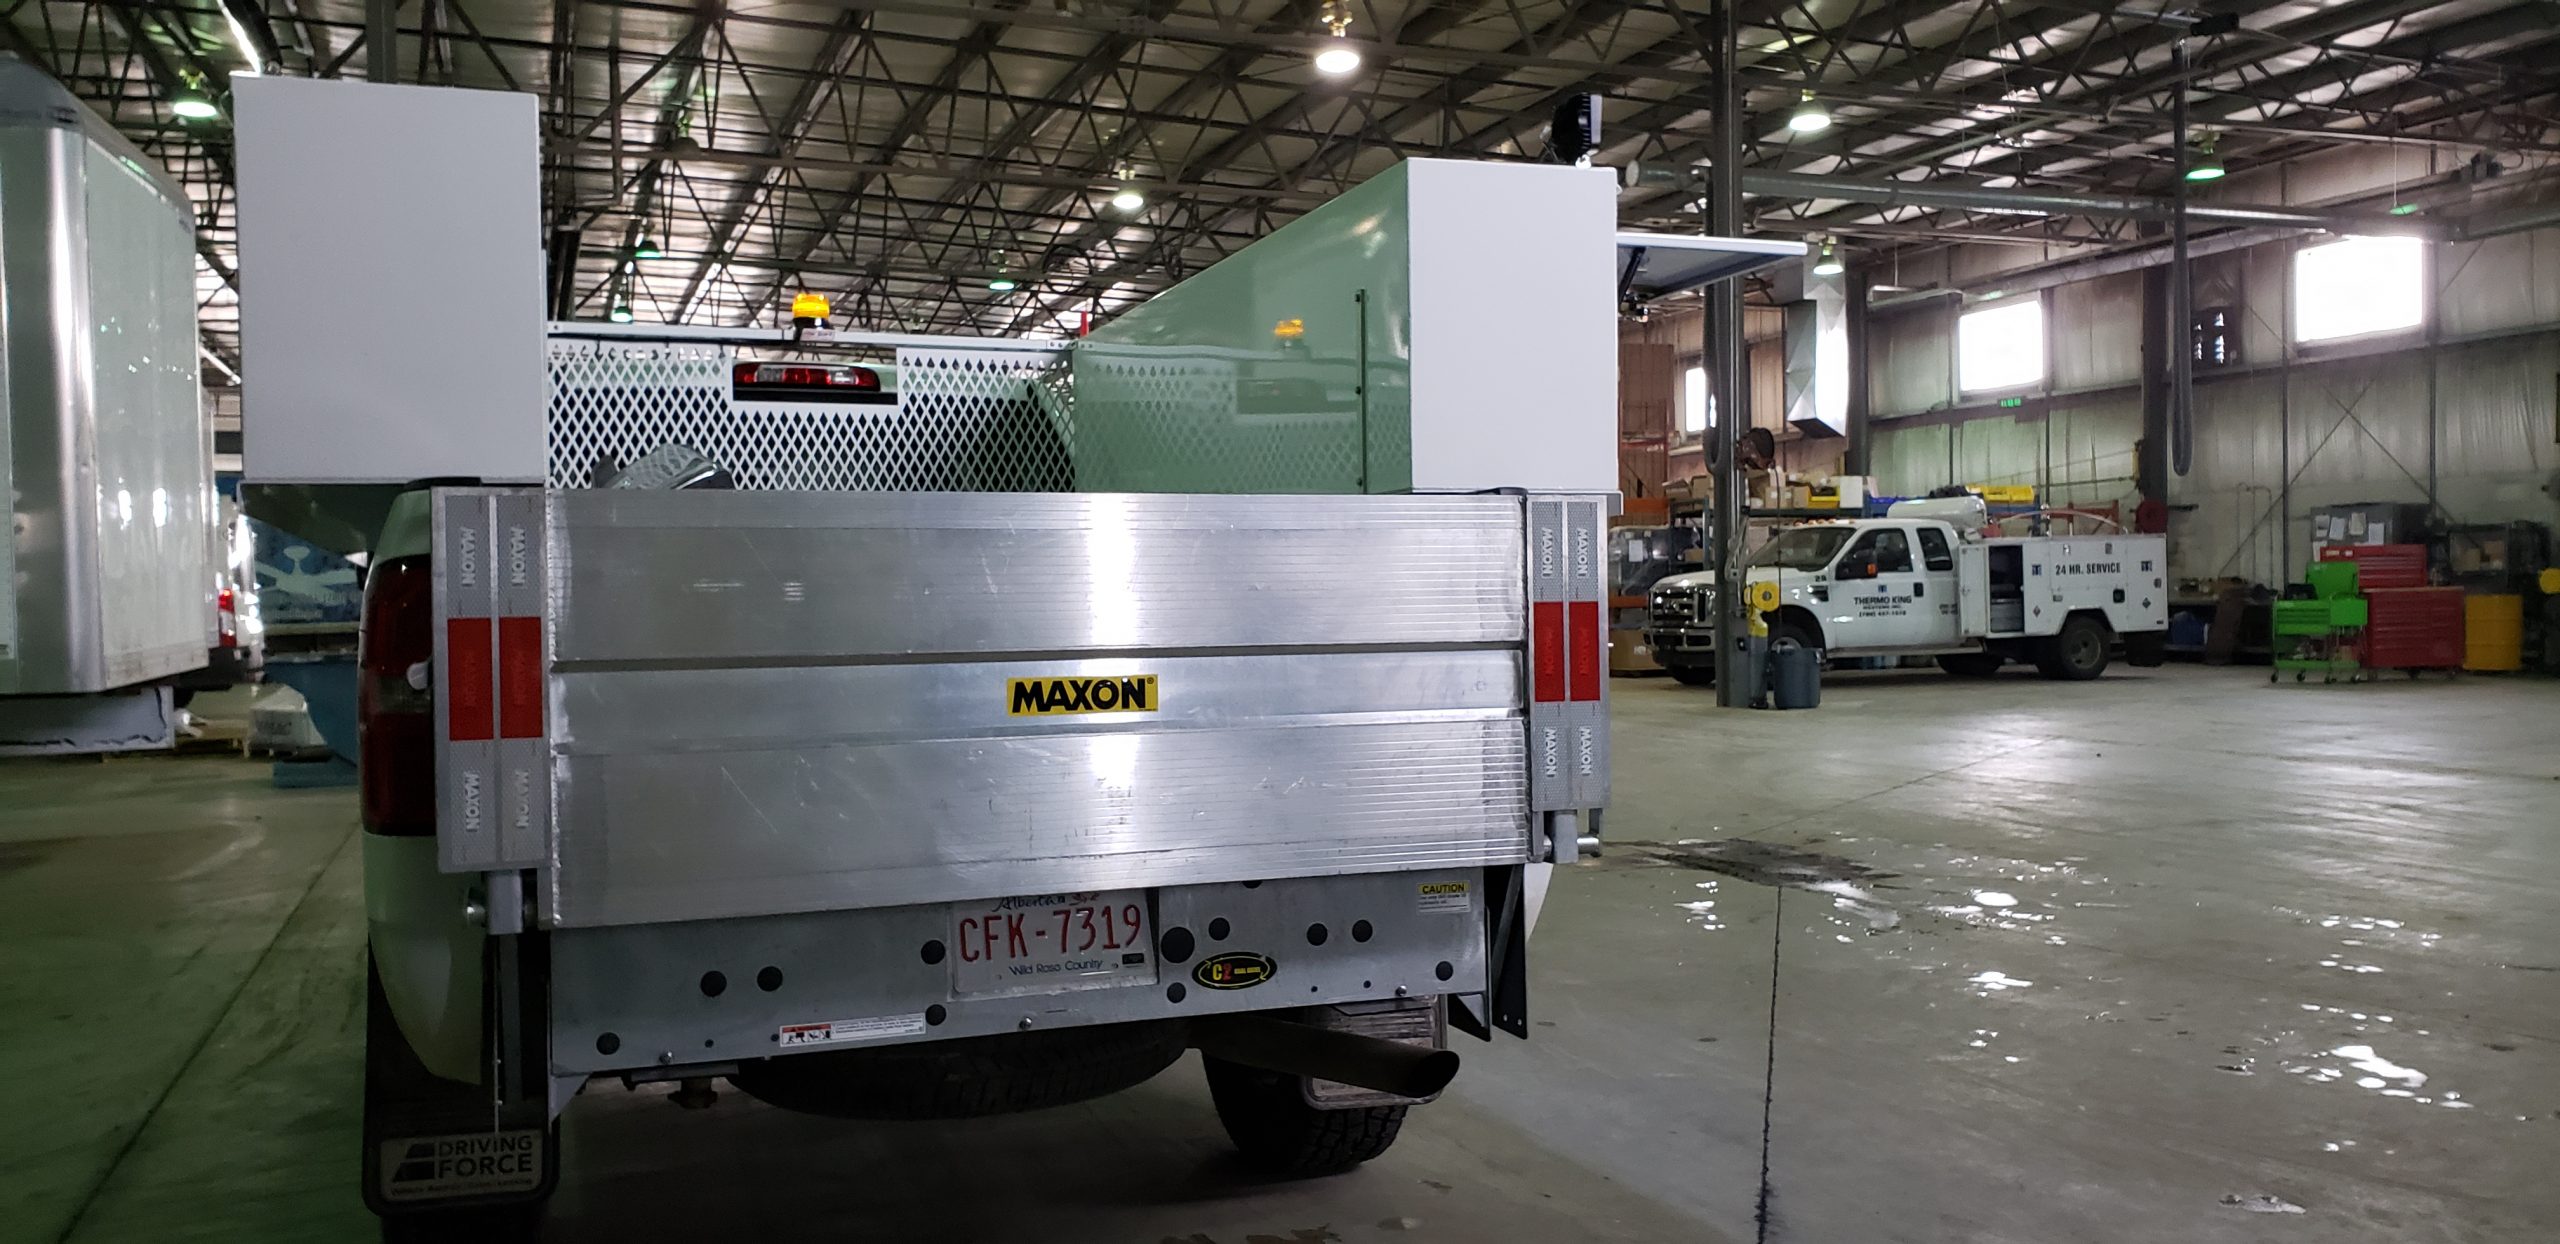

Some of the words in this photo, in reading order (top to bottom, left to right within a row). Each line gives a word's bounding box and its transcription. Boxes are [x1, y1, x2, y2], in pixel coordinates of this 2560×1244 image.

[460, 526, 476, 587] MAXON
[511, 526, 525, 587] MAXON
[1541, 527, 1553, 579] MAXON
[1576, 527, 1588, 579] MAXON
[2055, 563, 2066, 576] 24
[2069, 563, 2084, 575] HR.
[2086, 562, 2121, 575] SERVICE
[1854, 596, 1890, 605] THERMO
[1892, 595, 1912, 604] KING
[1012, 678, 1146, 714] MAXON
[1545, 727, 1557, 778] MAXON
[1580, 727, 1592, 777] MAXON
[465, 771, 480, 832] MAXON
[515, 770, 530, 829] MAXON
[1422, 883, 1465, 895] CAUTION
[959, 904, 1142, 963] CFK-7319
[1009, 964, 1033, 976] Wild
[1065, 959, 1104, 972] Country
[438, 1135, 533, 1158] DRIVING
[438, 1153, 533, 1179] FORCE
